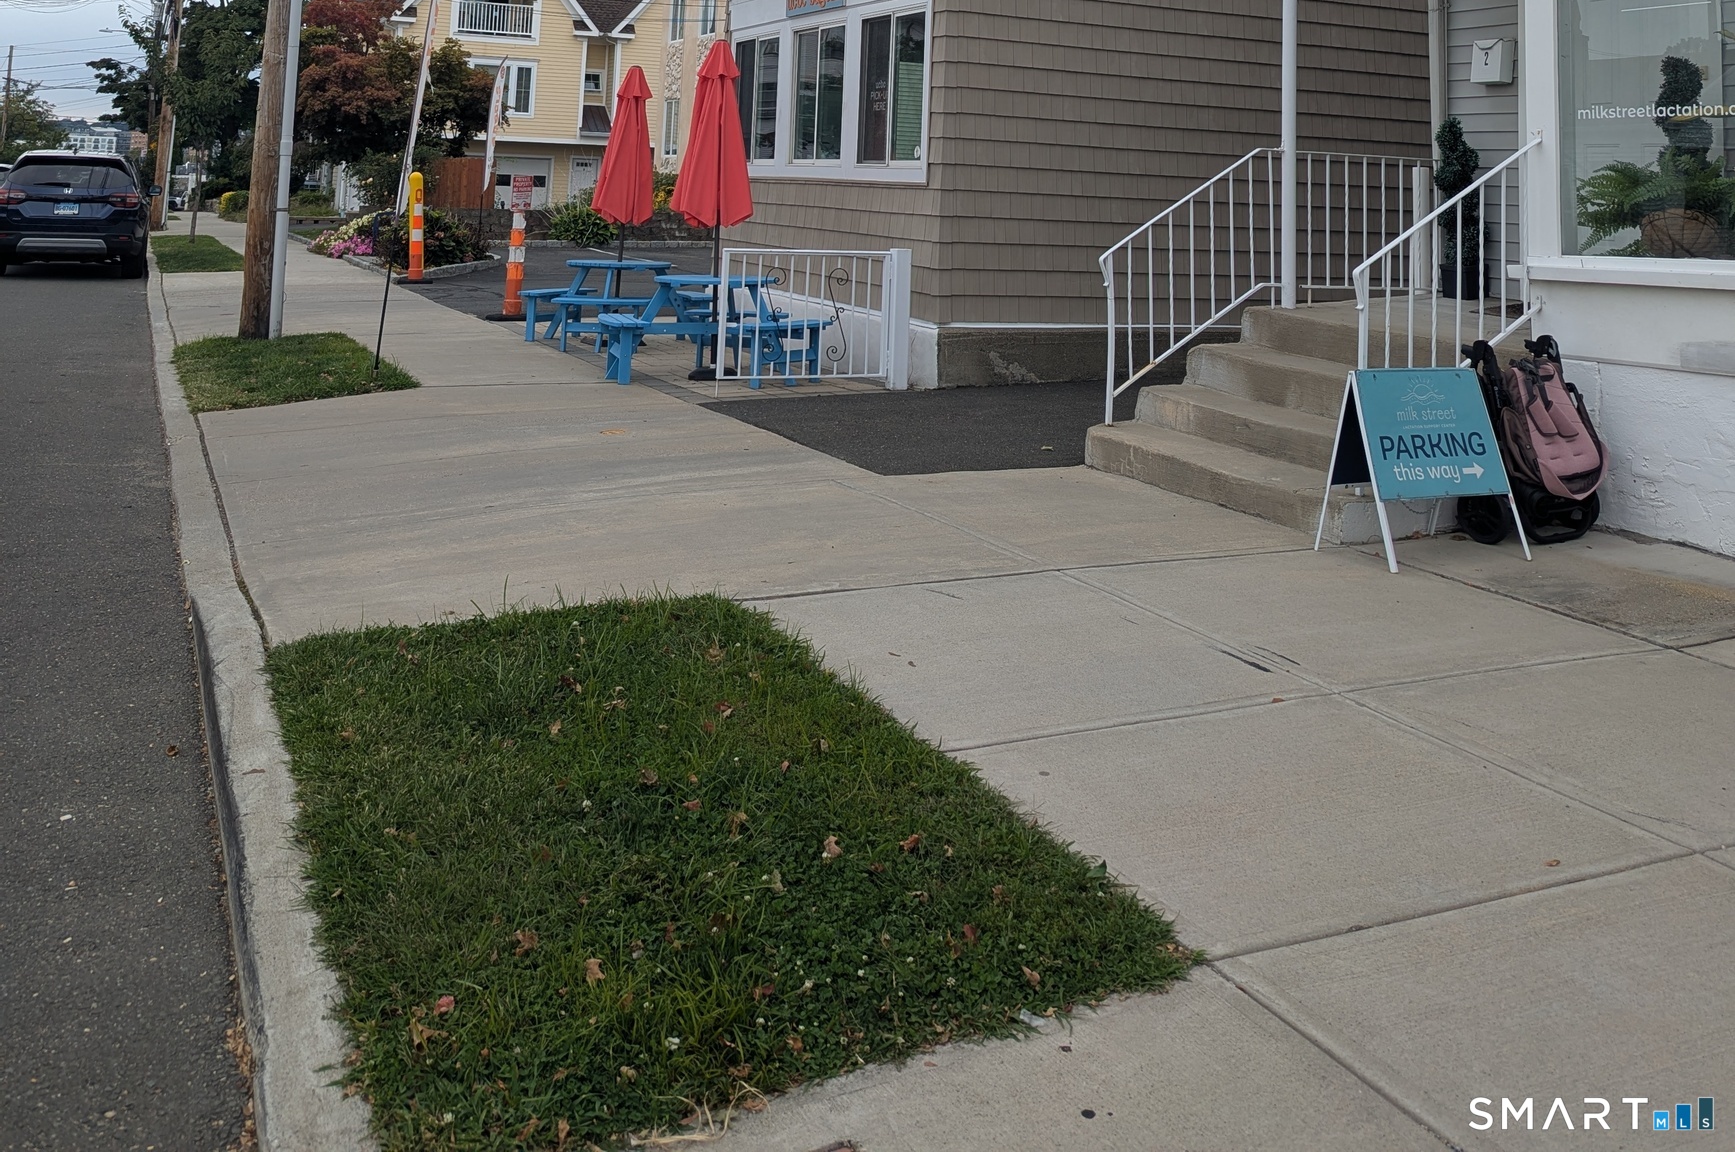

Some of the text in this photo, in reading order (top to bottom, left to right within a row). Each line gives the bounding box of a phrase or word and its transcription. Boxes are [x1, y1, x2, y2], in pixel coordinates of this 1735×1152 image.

[1484, 51, 1489, 66] 2
[1396, 406, 1457, 421] milk street
[1379, 432, 1487, 461] PARKING
[1393, 463, 1461, 483] this way
